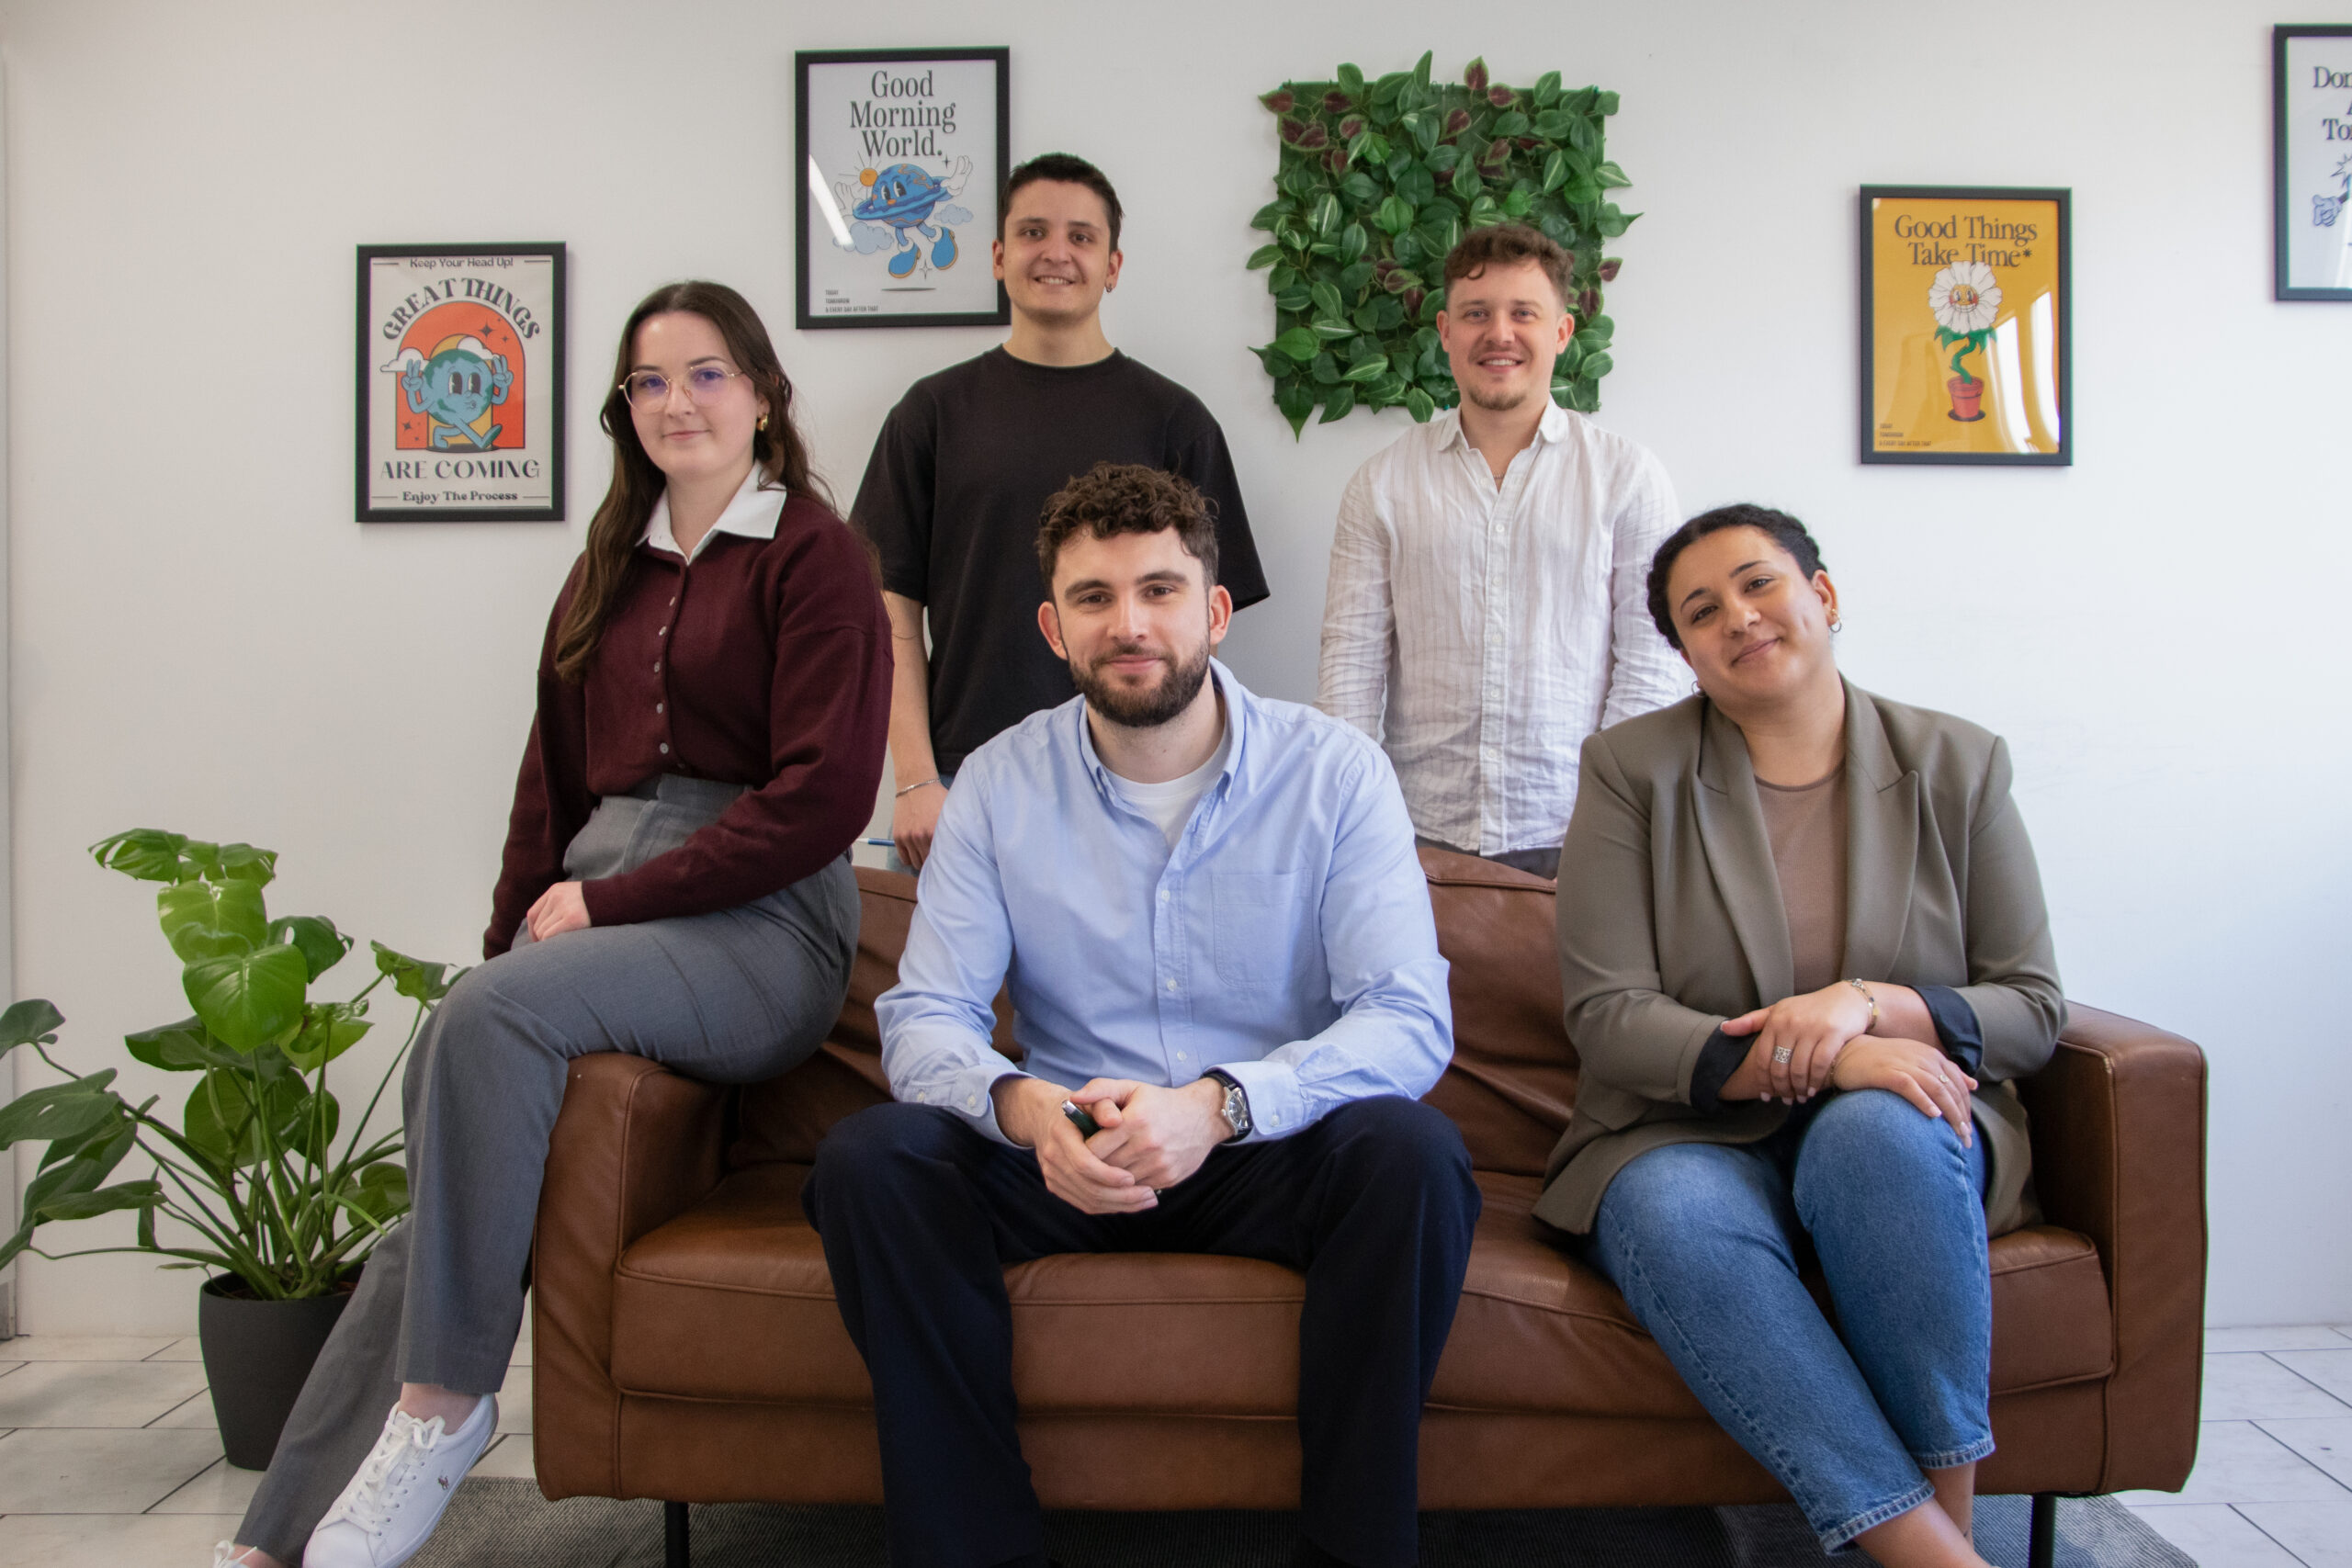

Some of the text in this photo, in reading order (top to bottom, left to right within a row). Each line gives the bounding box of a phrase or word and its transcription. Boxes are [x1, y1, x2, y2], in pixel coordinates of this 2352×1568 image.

[871, 70, 933, 97] Good
[850, 99, 956, 133] Morning
[2322, 118, 2352, 141] To
[861, 129, 943, 157] World.
[1894, 214, 2038, 247] Good Things
[410, 257, 514, 269] Keep Your Head Up!
[1907, 242, 1959, 265] Take
[382, 277, 540, 340] GREAT THINGS
[380, 459, 540, 479] ARE COMING
[402, 490, 518, 504] Enjoy The Process
